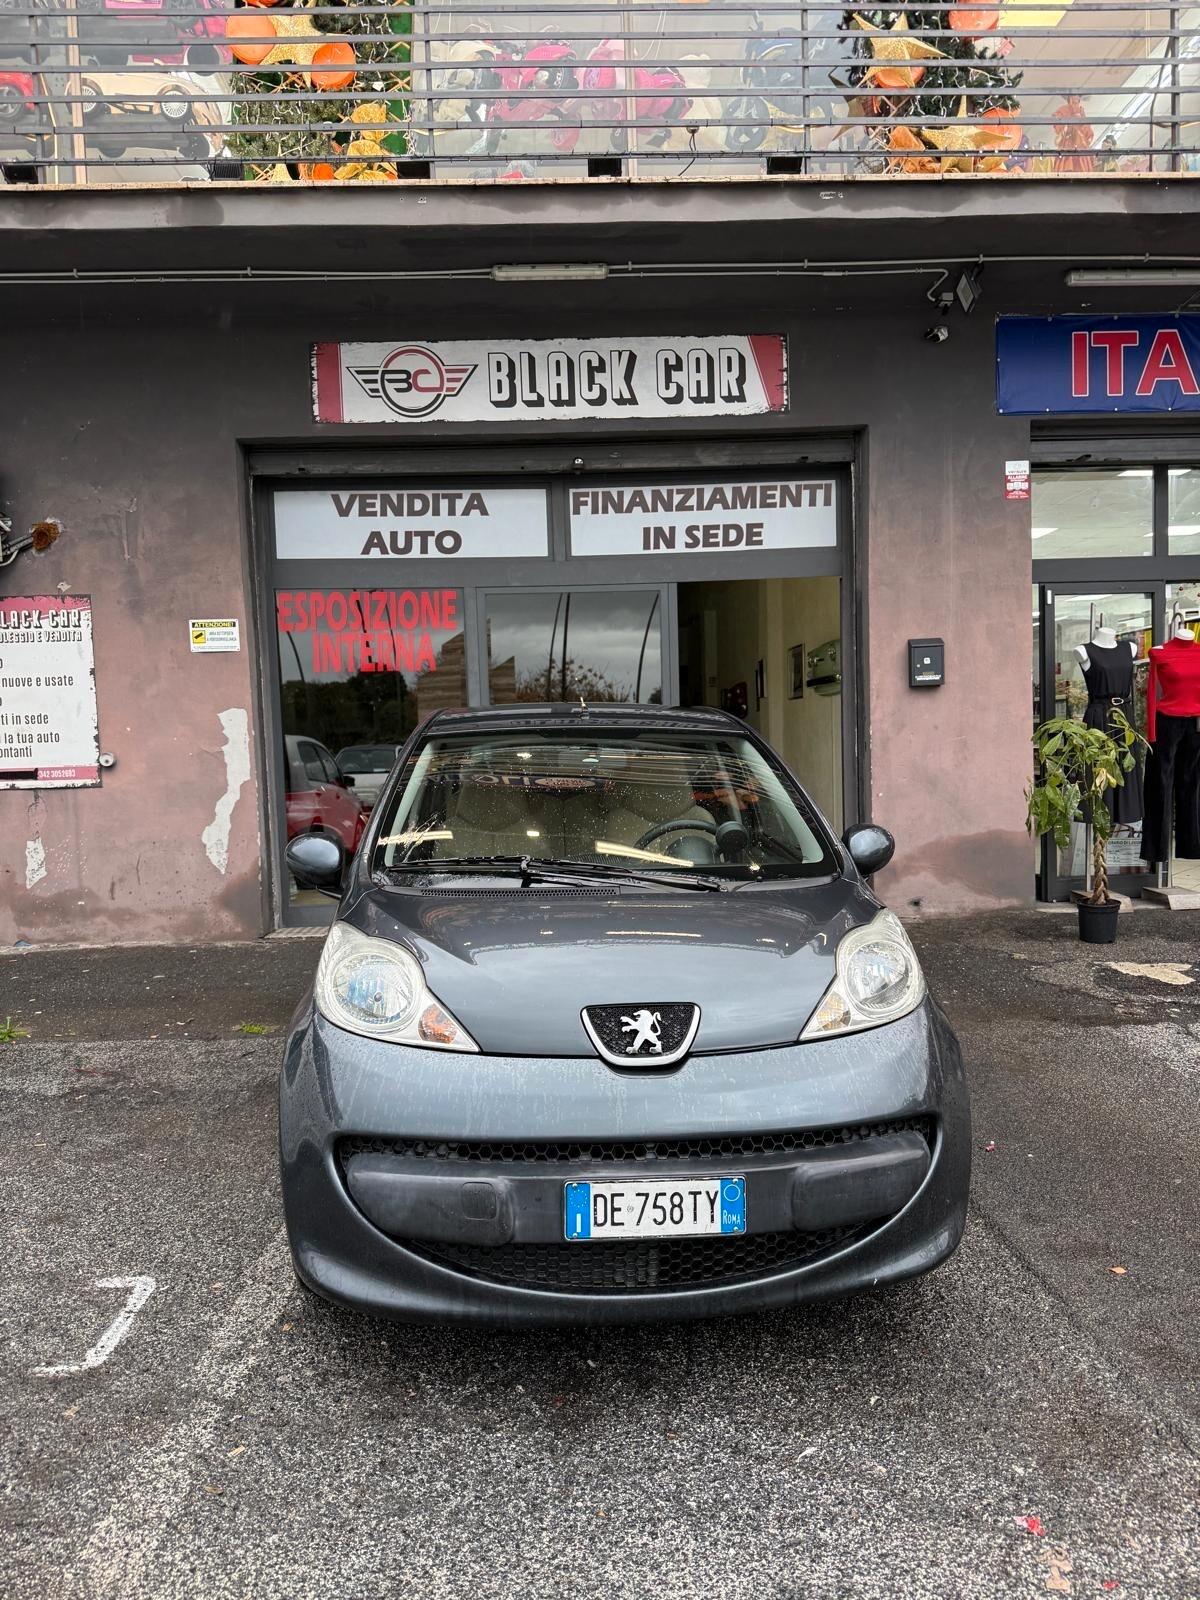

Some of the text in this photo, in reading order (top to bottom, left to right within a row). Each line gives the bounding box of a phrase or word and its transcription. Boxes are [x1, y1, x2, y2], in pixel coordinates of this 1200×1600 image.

[1072, 329, 1200, 396] ITA
[488, 348, 747, 408] BLACK CAR
[331, 492, 489, 518] VENDITA
[572, 483, 833, 516] FINANZIAMENTI
[360, 529, 462, 556] AUTO
[642, 522, 764, 551] IN SEDE
[48, 609, 82, 628] CAR
[276, 590, 457, 633] ESPOSIZIONE
[45, 629, 83, 642] VENDITA
[311, 632, 437, 673] INTERNA
[1, 674, 74, 688] nuove e usate
[11, 713, 22, 725] in
[24, 712, 49, 725] sede
[4, 731, 60, 744] la tua auto
[592, 1190, 719, 1228] DE 758TY
